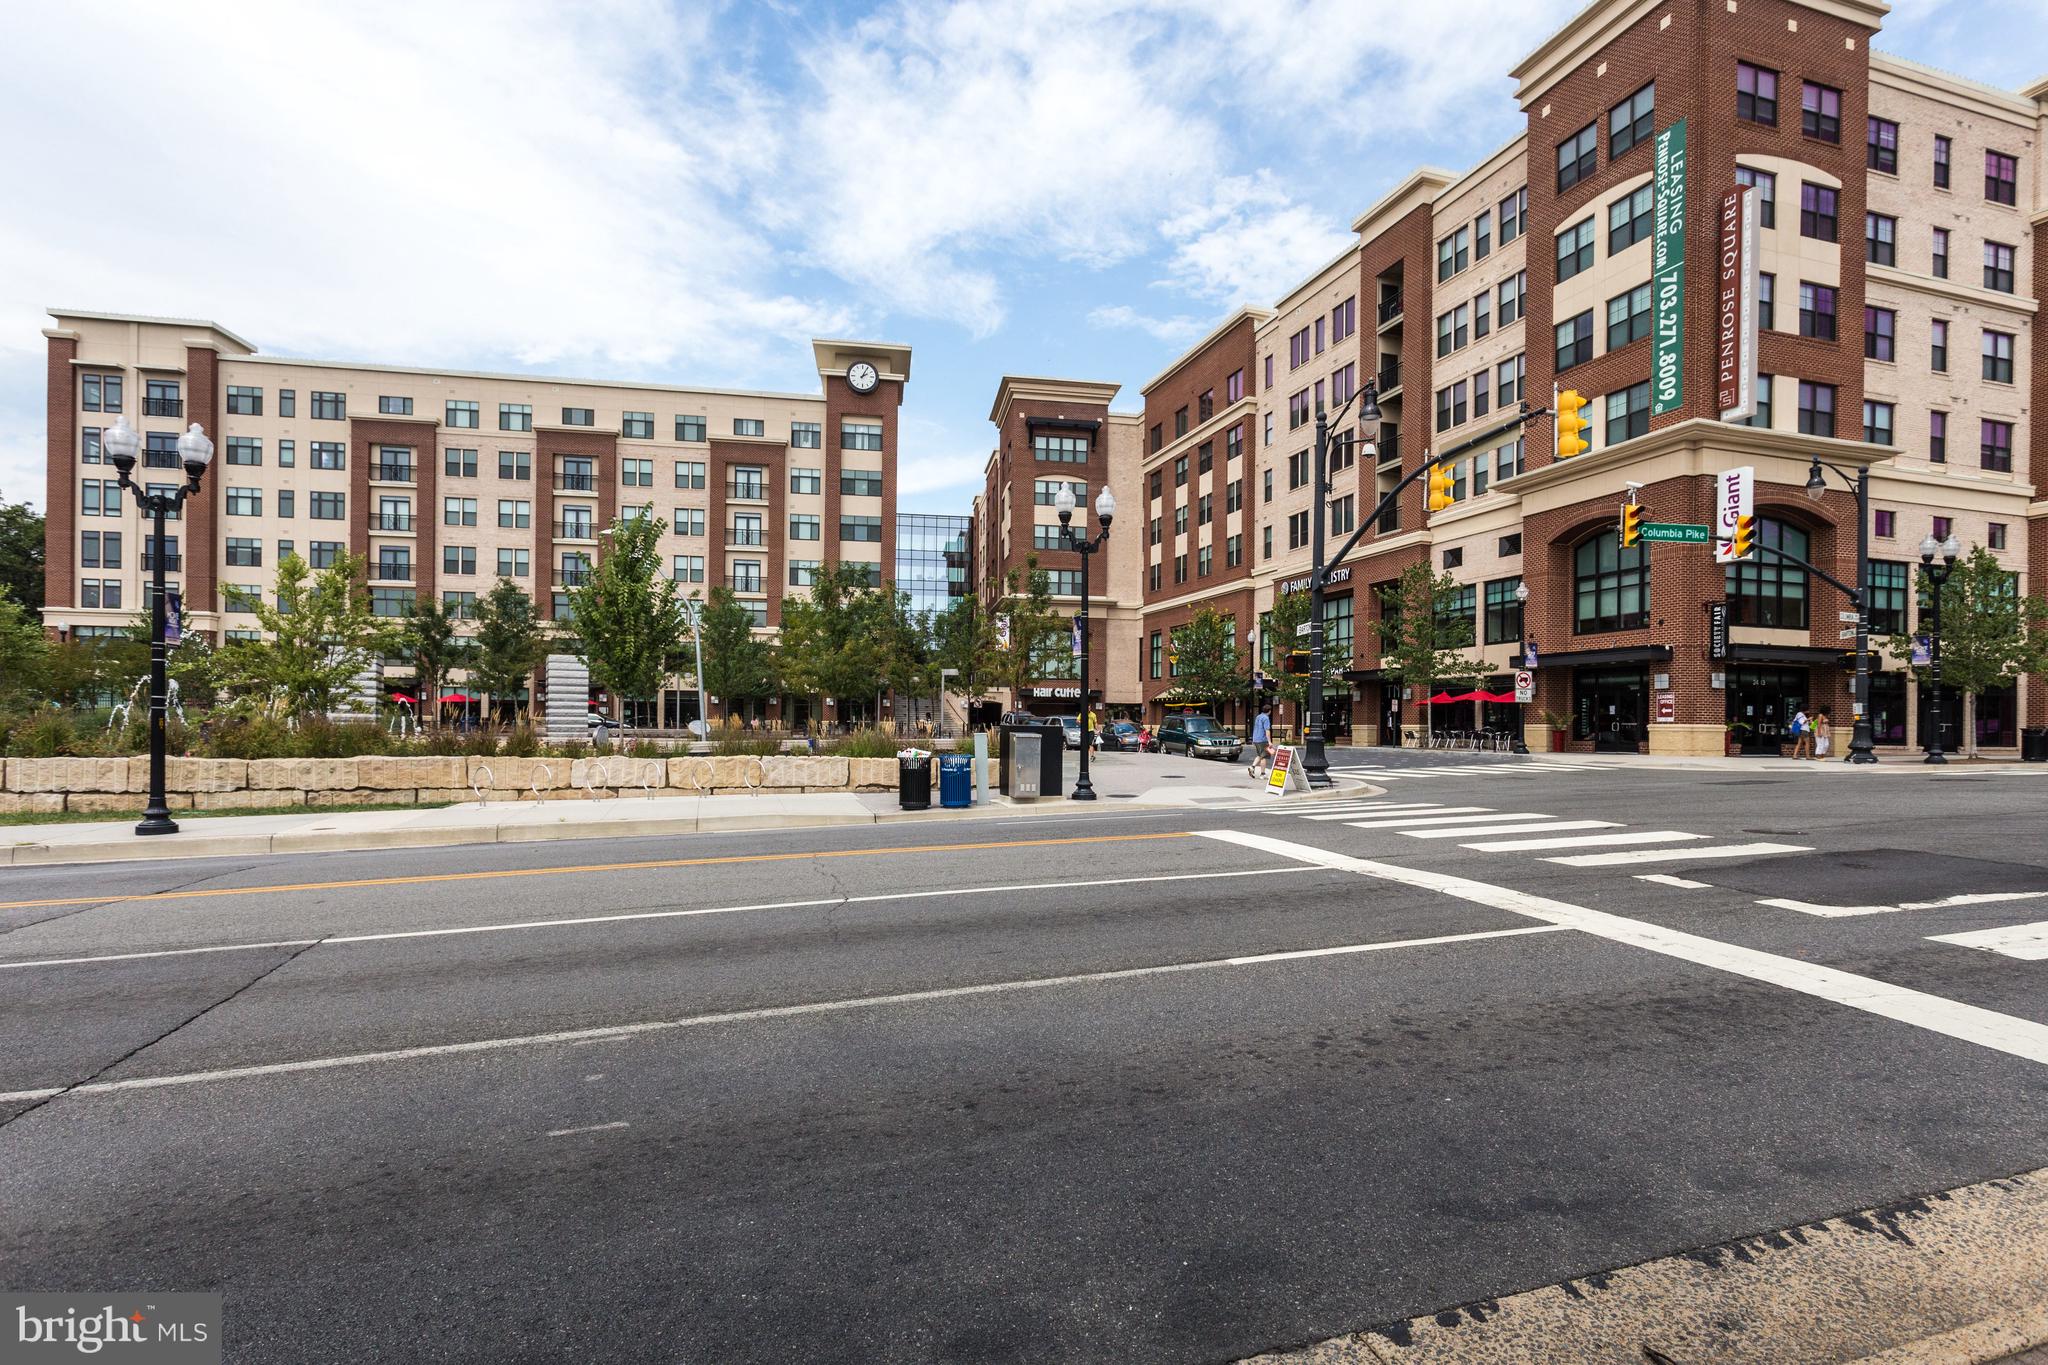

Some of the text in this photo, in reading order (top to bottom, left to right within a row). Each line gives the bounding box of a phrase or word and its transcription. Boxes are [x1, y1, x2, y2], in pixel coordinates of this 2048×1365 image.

[1670, 150, 1684, 235] LEASING
[1721, 193, 1738, 382] PENROSE SQUARE
[1658, 271, 1678, 401] 703.271.8009
[1722, 473, 1740, 528] Giant
[1641, 527, 1705, 539] Columbia Pike
[1290, 576, 1312, 592] FAMILY
[1713, 606, 1721, 658] SOCIETY FAIR
[1033, 688, 1090, 698] Hair Cutte
